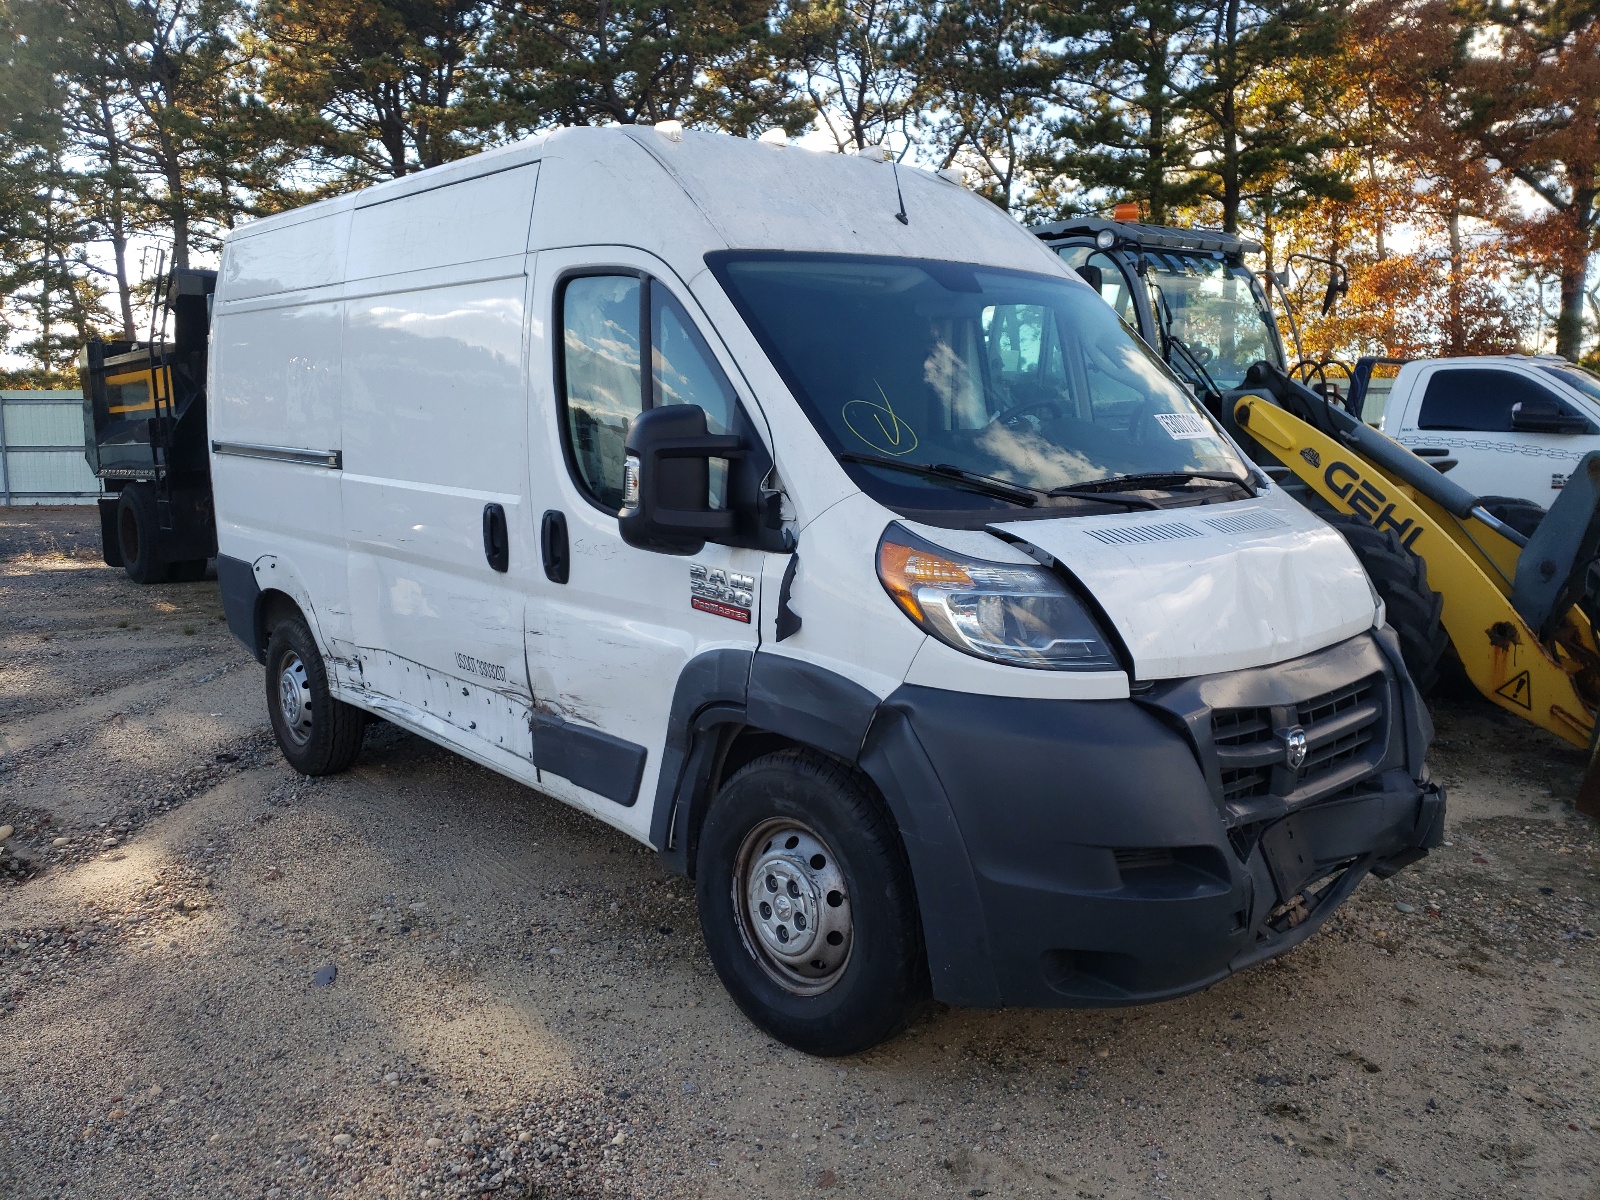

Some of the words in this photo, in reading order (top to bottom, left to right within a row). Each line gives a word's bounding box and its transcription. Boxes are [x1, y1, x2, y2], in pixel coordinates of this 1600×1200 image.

[1325, 461, 1424, 558] GEHL
[690, 564, 755, 592] RAM
[691, 579, 754, 608] 2500
[454, 651, 477, 673] USDOT
